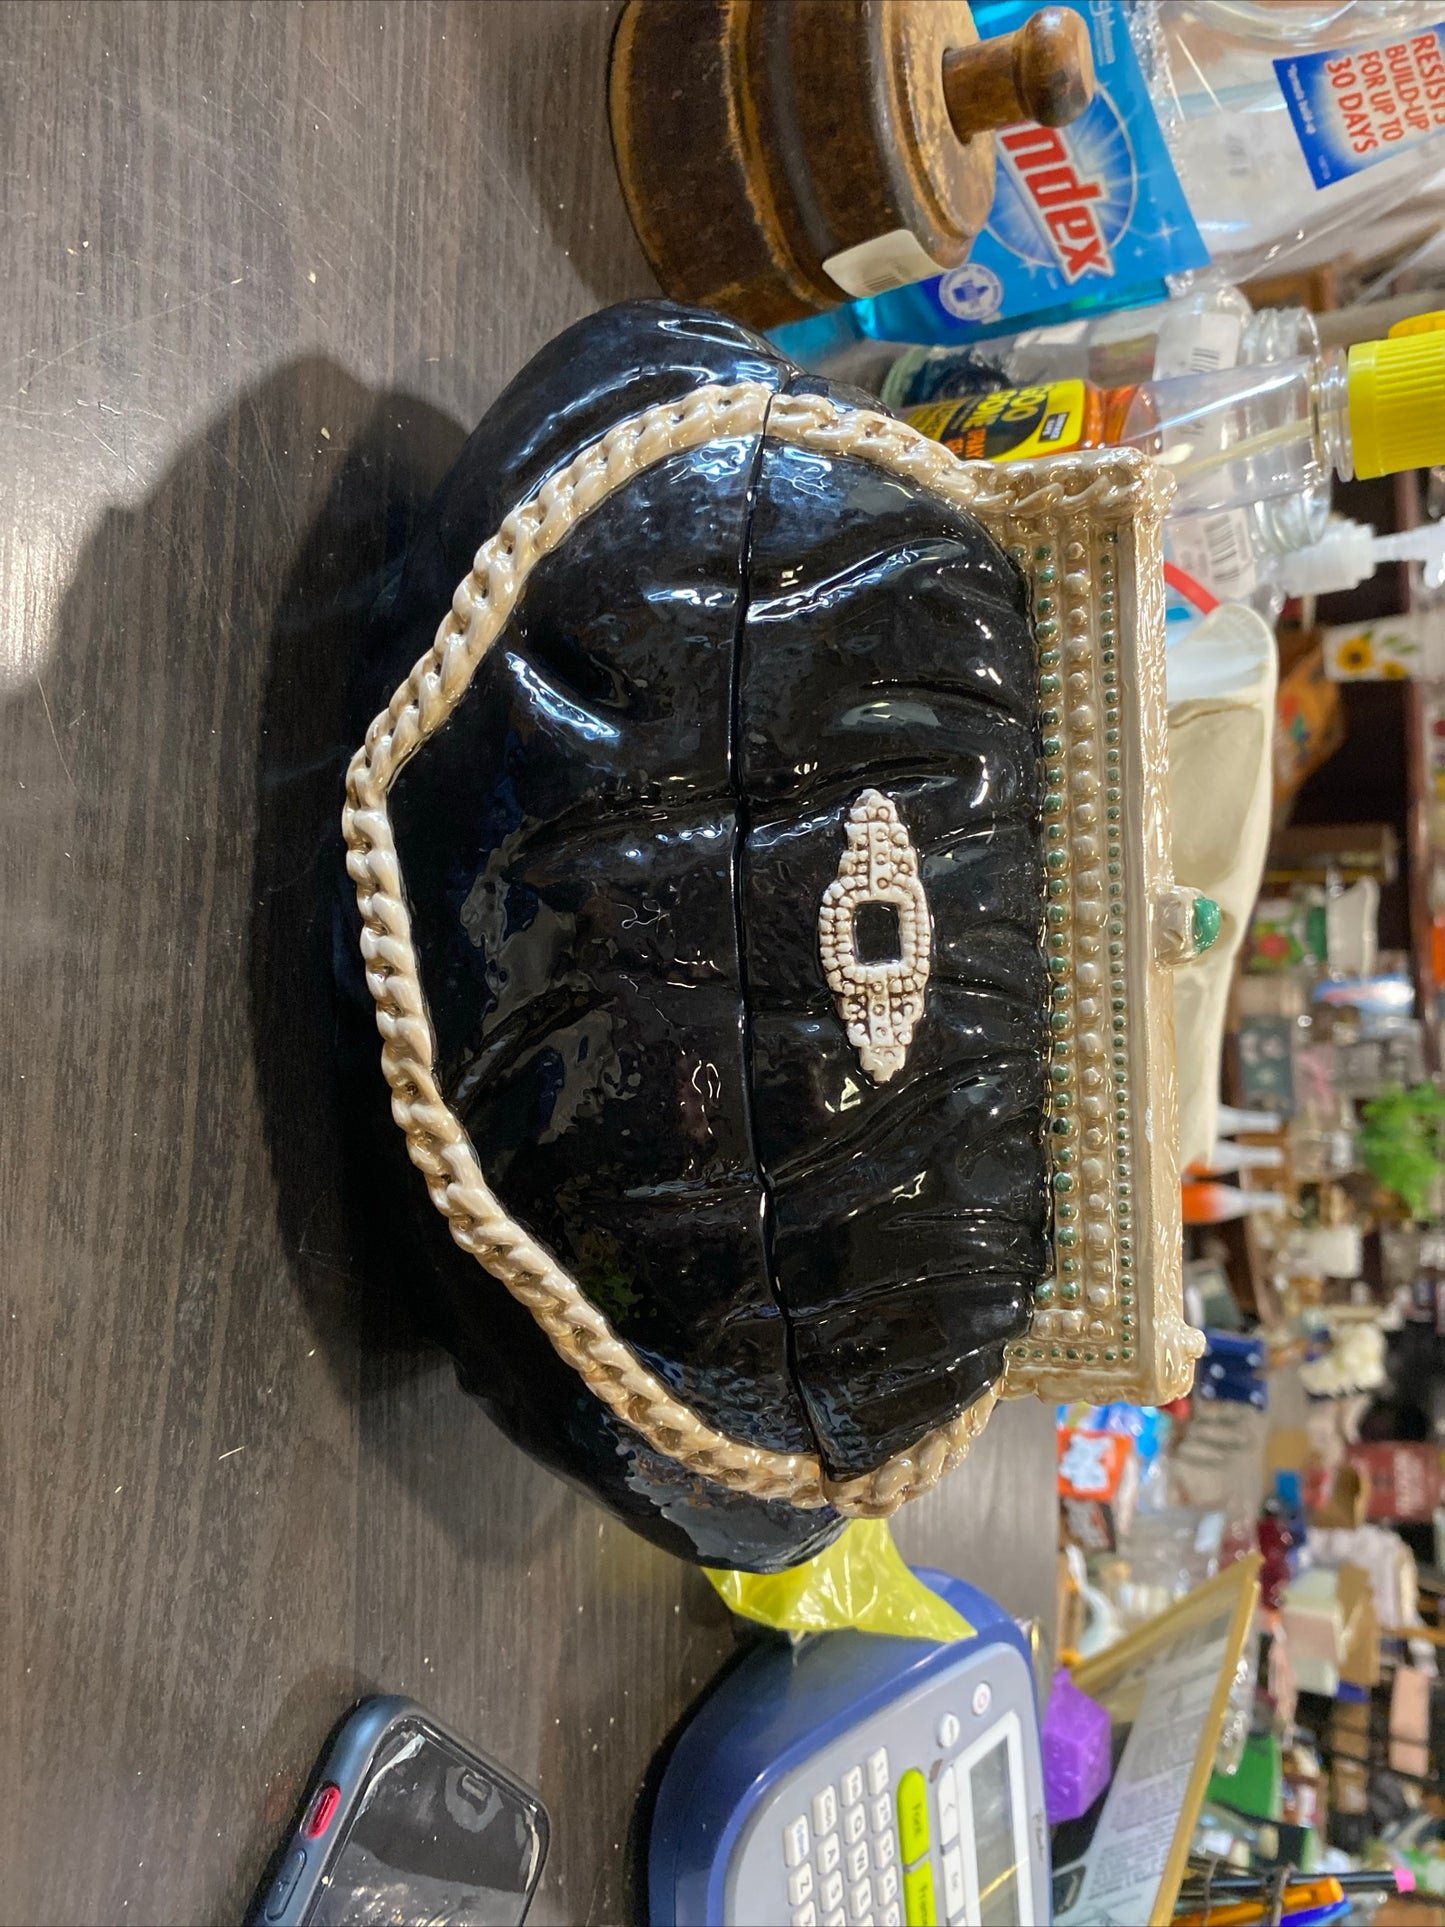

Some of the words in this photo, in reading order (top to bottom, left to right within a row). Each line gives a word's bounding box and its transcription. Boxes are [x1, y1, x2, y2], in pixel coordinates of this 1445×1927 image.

[1326, 57, 1357, 89] 30
[1357, 51, 1387, 89] FOR
[1370, 90, 1396, 114] UP
[1337, 92, 1378, 153] DAYS
[1378, 118, 1404, 141] TO
[1000, 126, 1106, 276] ndex
[1001, 384, 1056, 422] GOO
[854, 1816, 863, 1834] Q
[912, 1802, 922, 1838] Font
[826, 1849, 836, 1864] A
[856, 1850, 866, 1870] W
[800, 1878, 810, 1895] Z
